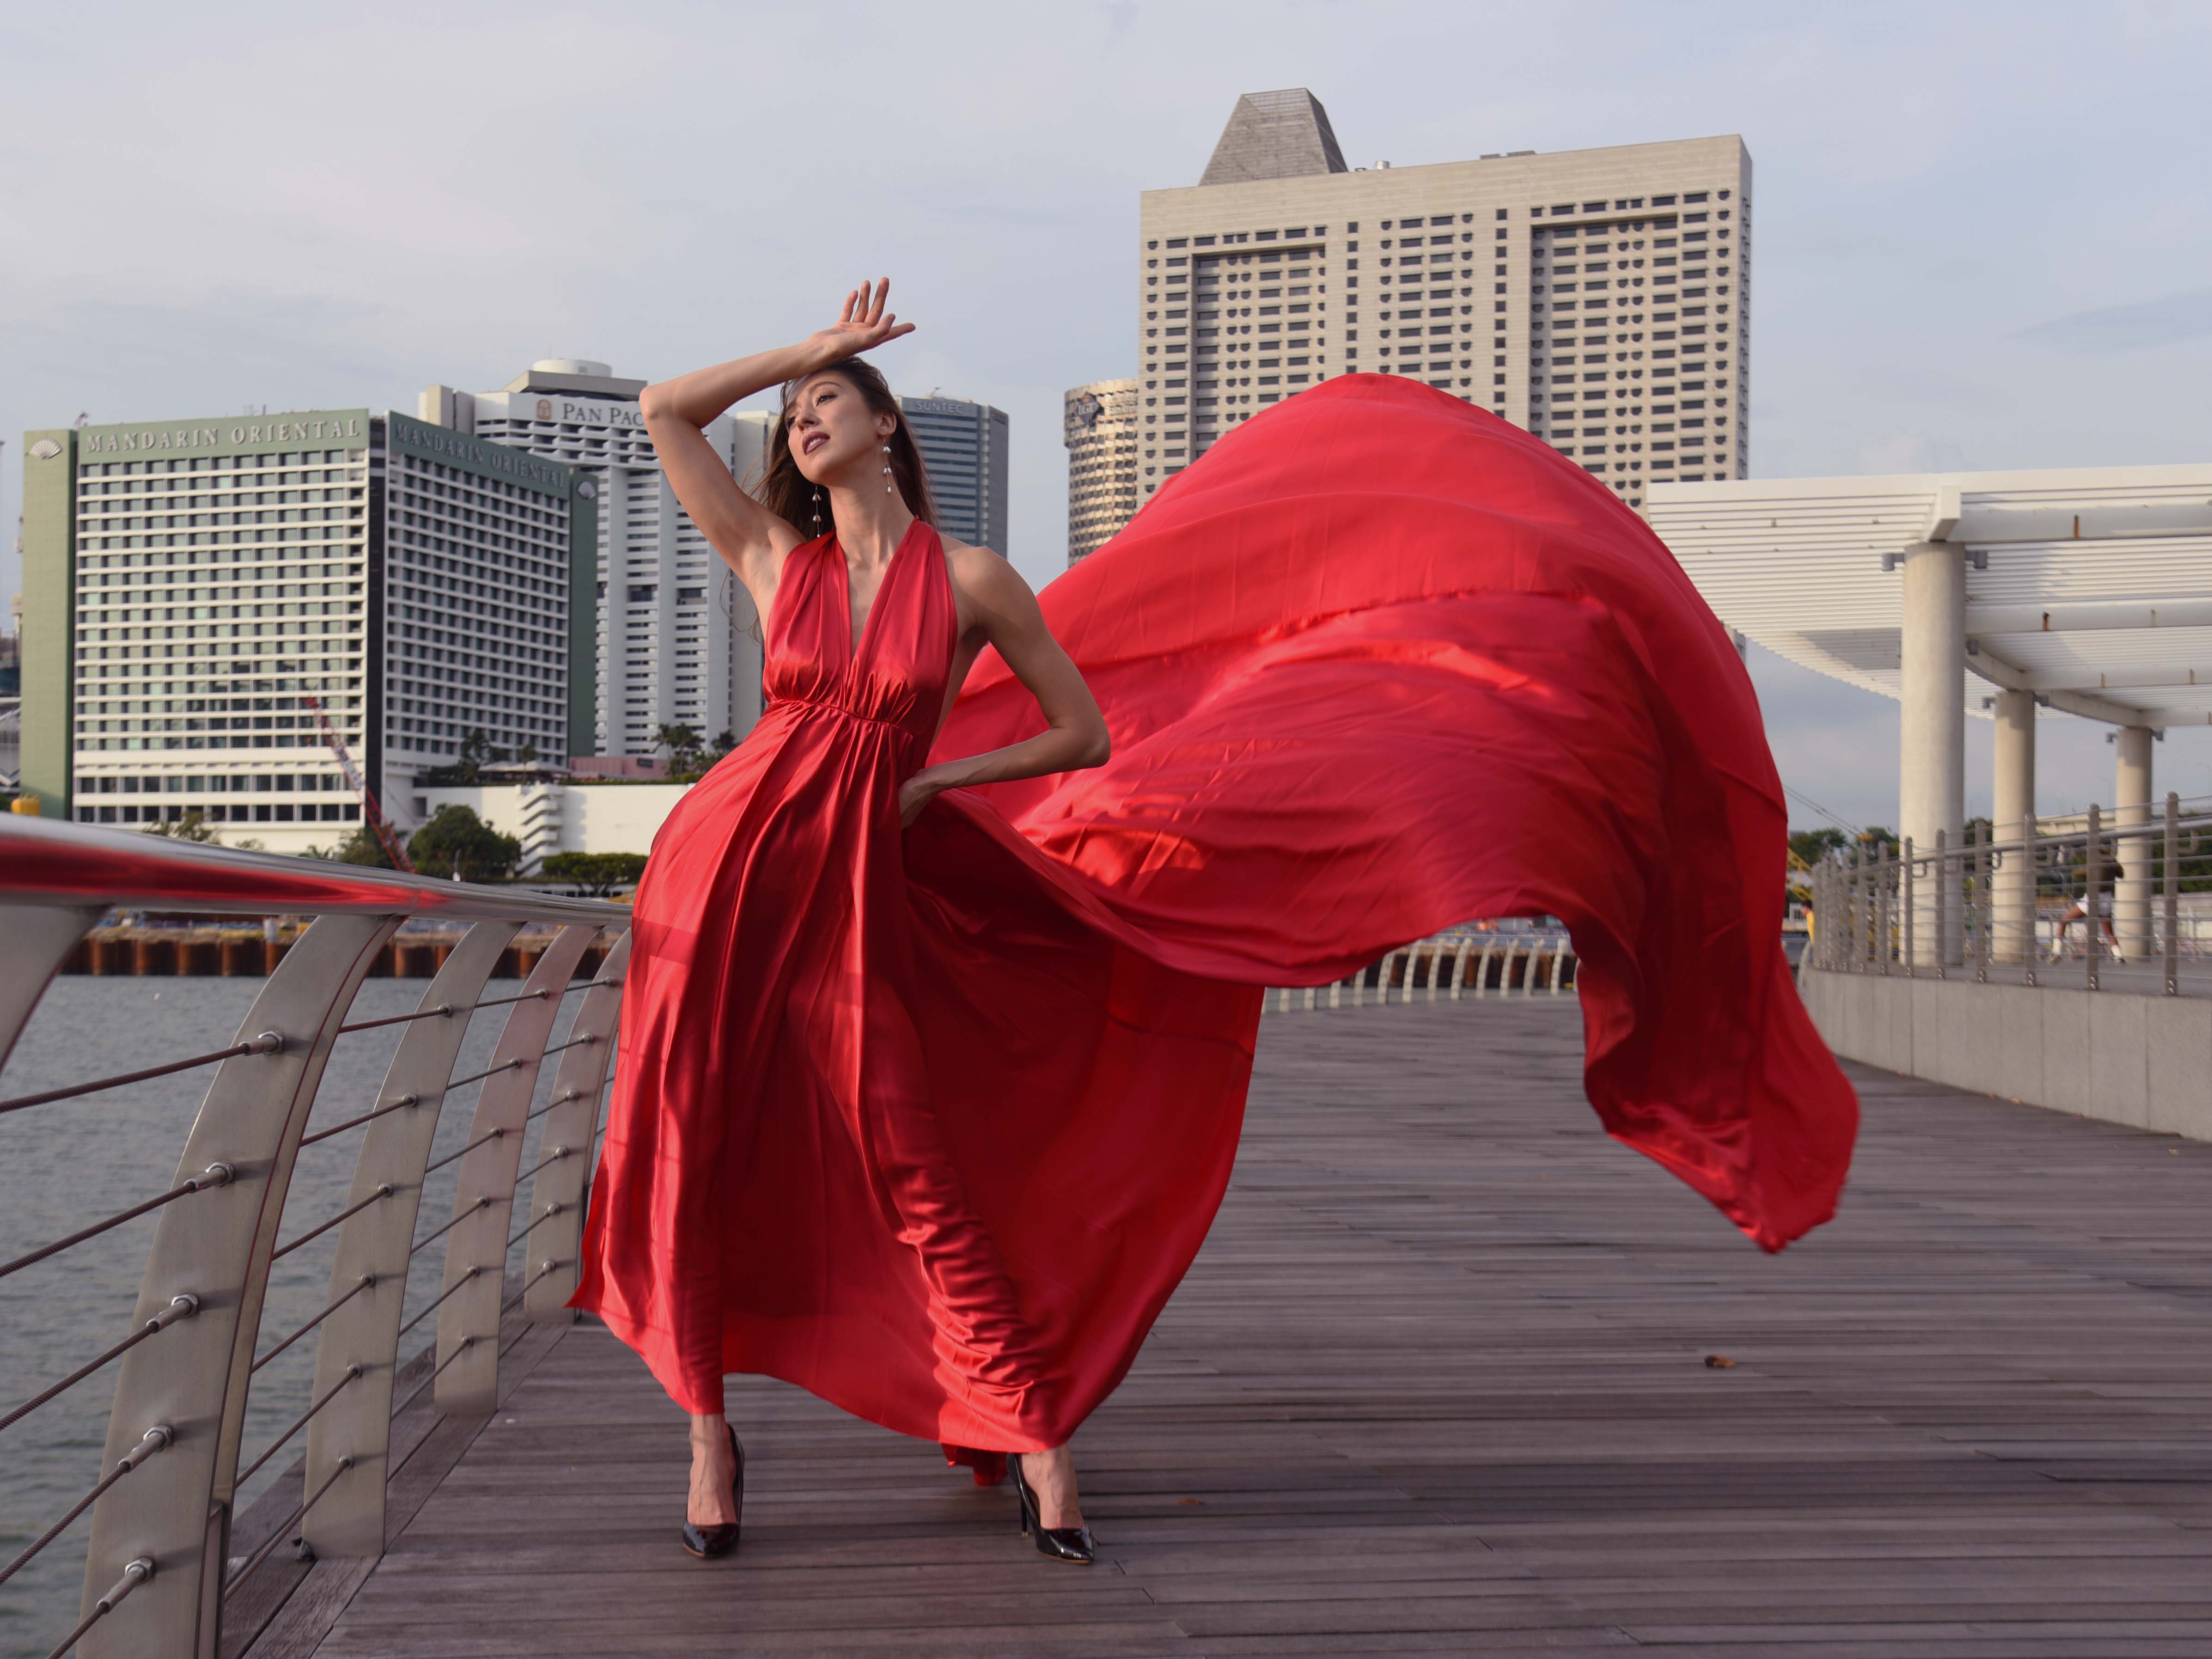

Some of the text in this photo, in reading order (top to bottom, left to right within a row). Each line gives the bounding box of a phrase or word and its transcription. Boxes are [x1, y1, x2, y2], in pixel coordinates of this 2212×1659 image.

[562, 403, 602, 421] PAN
[915, 401, 963, 414] SUNTEC
[86, 419, 360, 452] MANDARIN ORIENTAL
[395, 422, 566, 488] MANDARIN ORIENTAL
